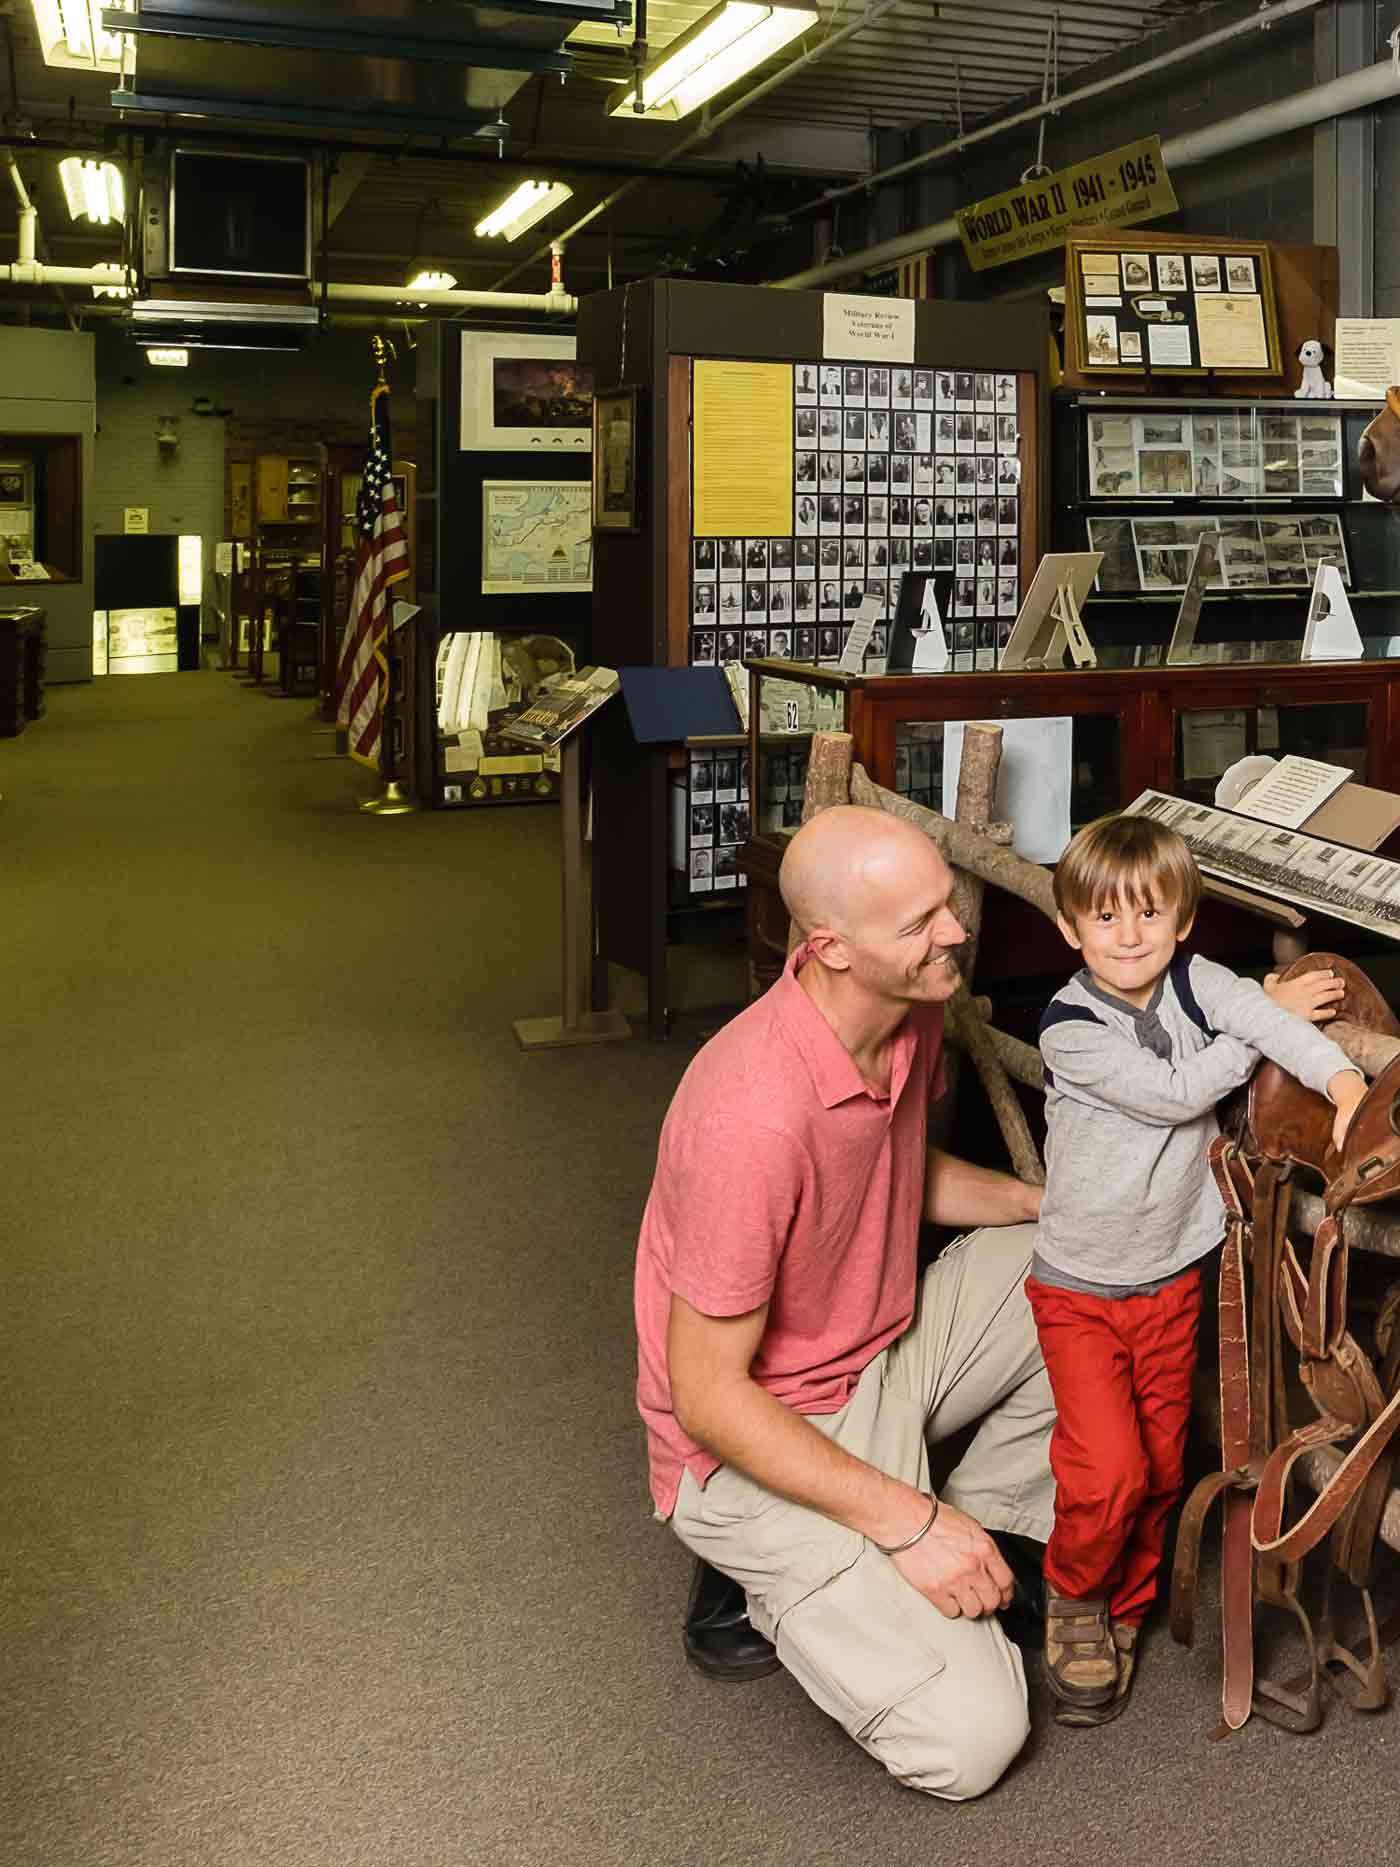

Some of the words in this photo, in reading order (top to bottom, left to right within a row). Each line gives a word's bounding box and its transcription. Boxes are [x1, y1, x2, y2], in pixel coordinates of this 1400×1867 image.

[962, 207, 1012, 243] WORLD
[1011, 193, 1051, 227] WAR
[1050, 182, 1067, 215] II
[1072, 172, 1106, 208] 1941
[1119, 153, 1157, 192] 1945
